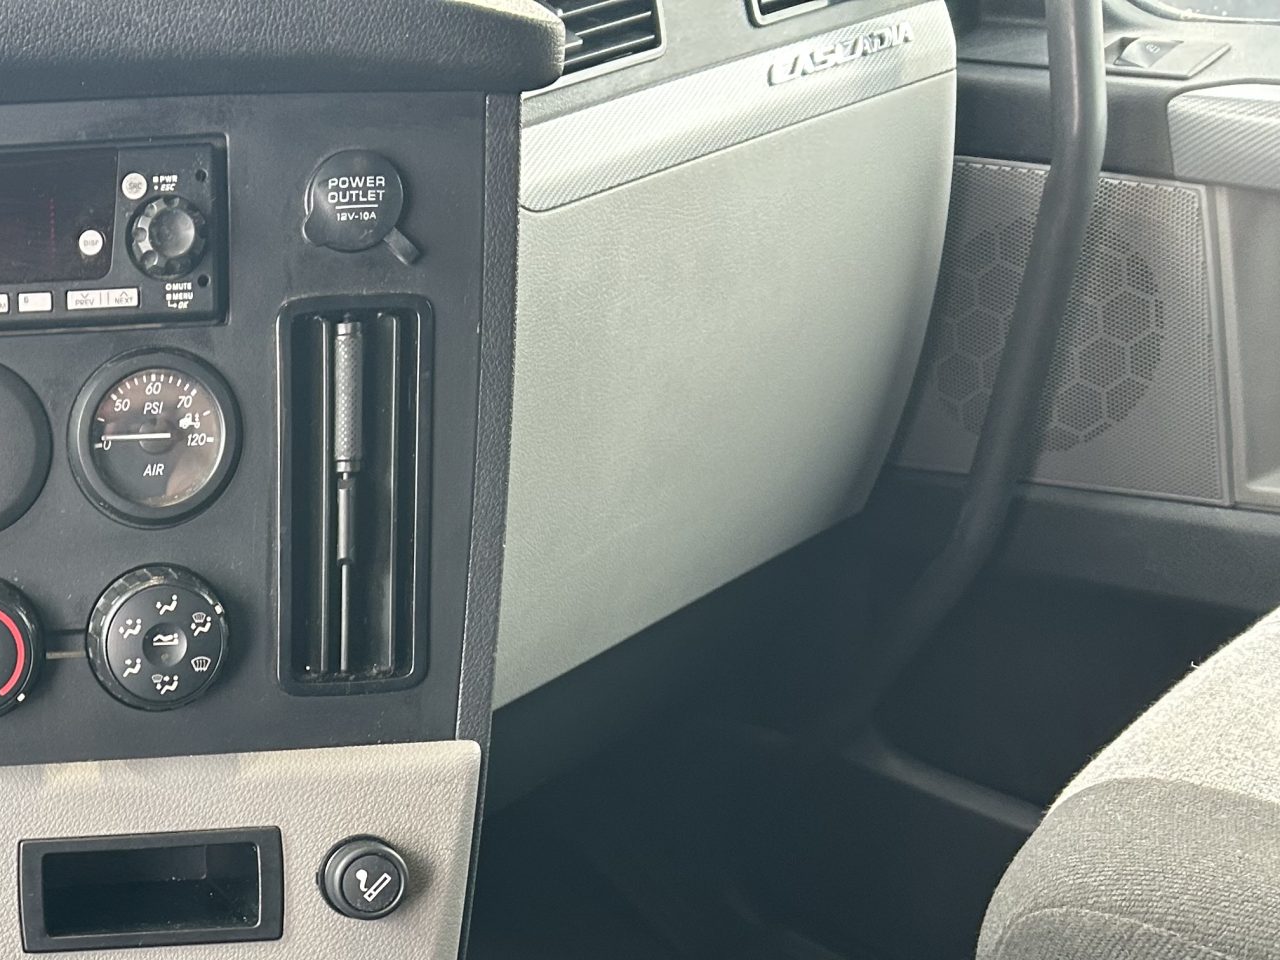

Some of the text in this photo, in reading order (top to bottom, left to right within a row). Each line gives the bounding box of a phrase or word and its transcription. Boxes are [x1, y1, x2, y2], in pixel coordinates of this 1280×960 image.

[160, 175, 178, 183] PWR
[328, 176, 385, 189] POWER
[327, 190, 385, 203] OUTLET
[336, 211, 377, 221] 12V-10A
[172, 282, 192, 290] MUTE
[172, 292, 193, 300] MENU
[178, 301, 189, 309] OK
[145, 382, 162, 395] 60
[114, 399, 130, 412] 50
[176, 395, 193, 408] 70
[143, 402, 164, 415] PSI
[187, 433, 206, 446] 120
[143, 463, 164, 476] AIR
